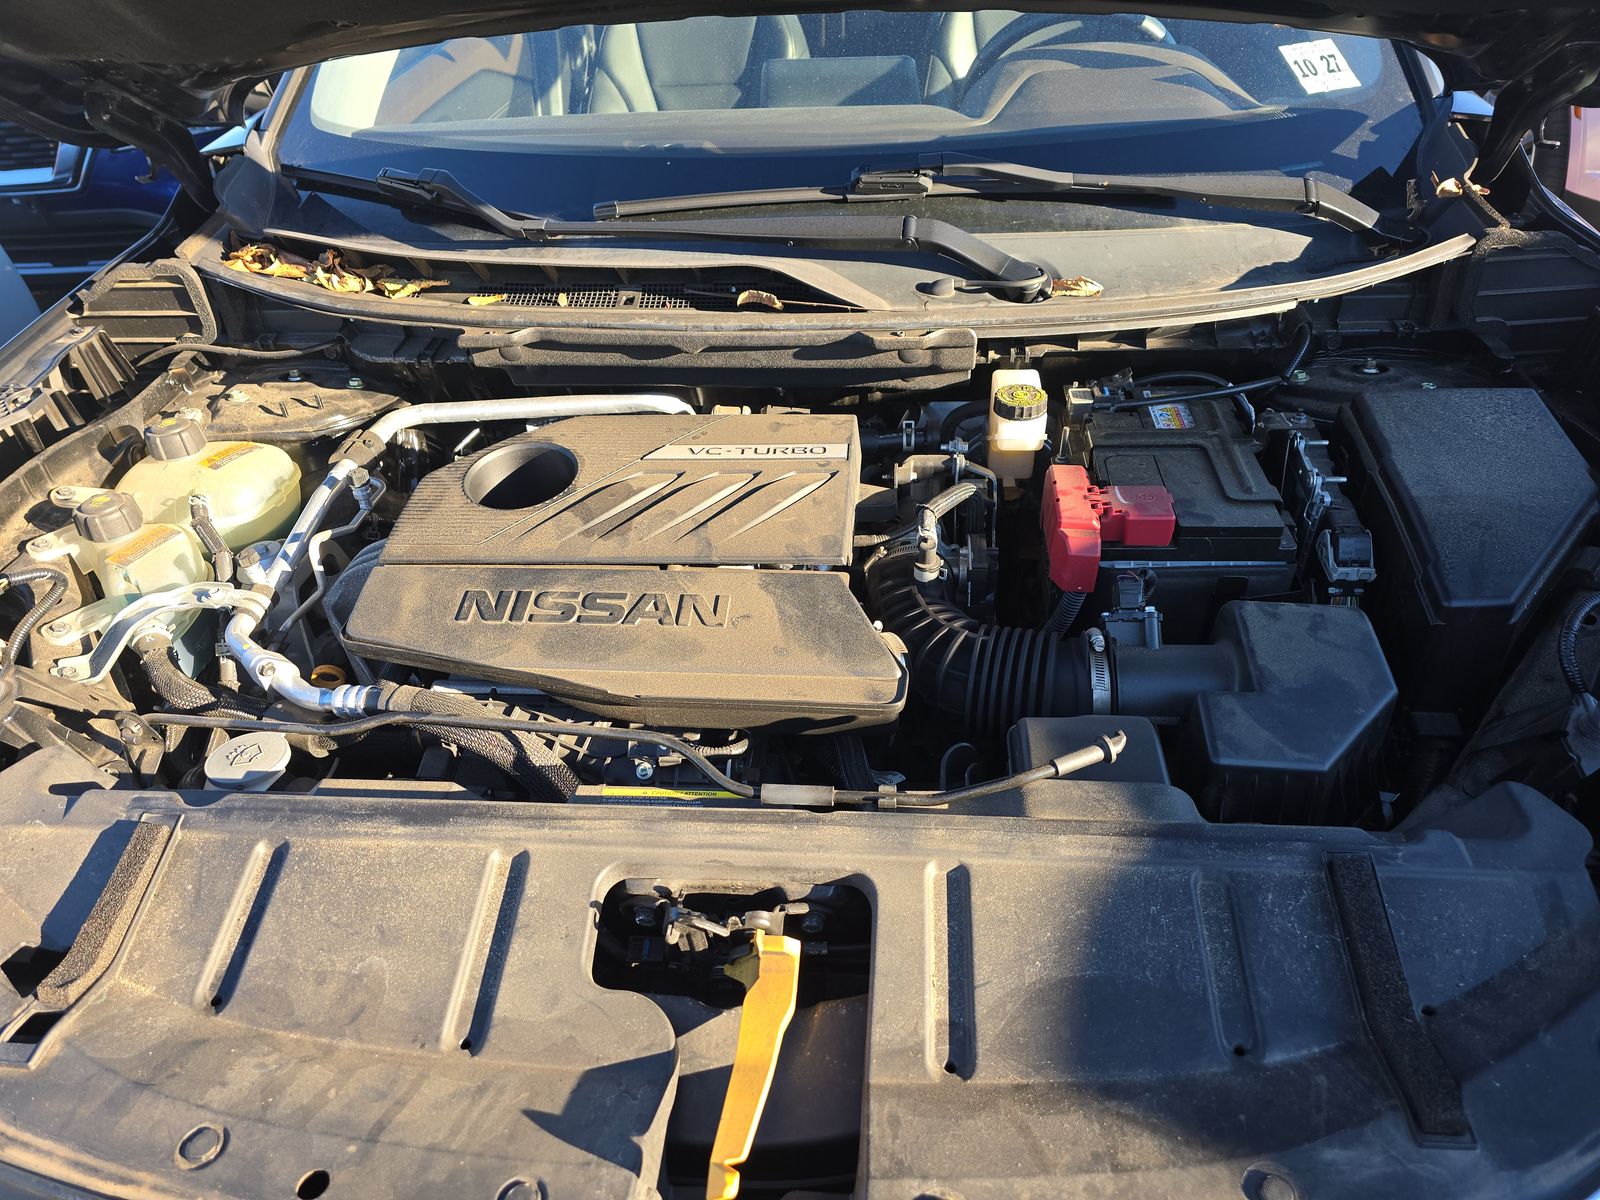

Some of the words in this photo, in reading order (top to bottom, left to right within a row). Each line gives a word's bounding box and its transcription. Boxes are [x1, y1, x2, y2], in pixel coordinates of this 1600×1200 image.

[1293, 58, 1318, 78] 10
[1320, 53, 1342, 73] 27
[688, 446, 827, 456] VC-TURBO
[453, 589, 731, 628] NISSAN
